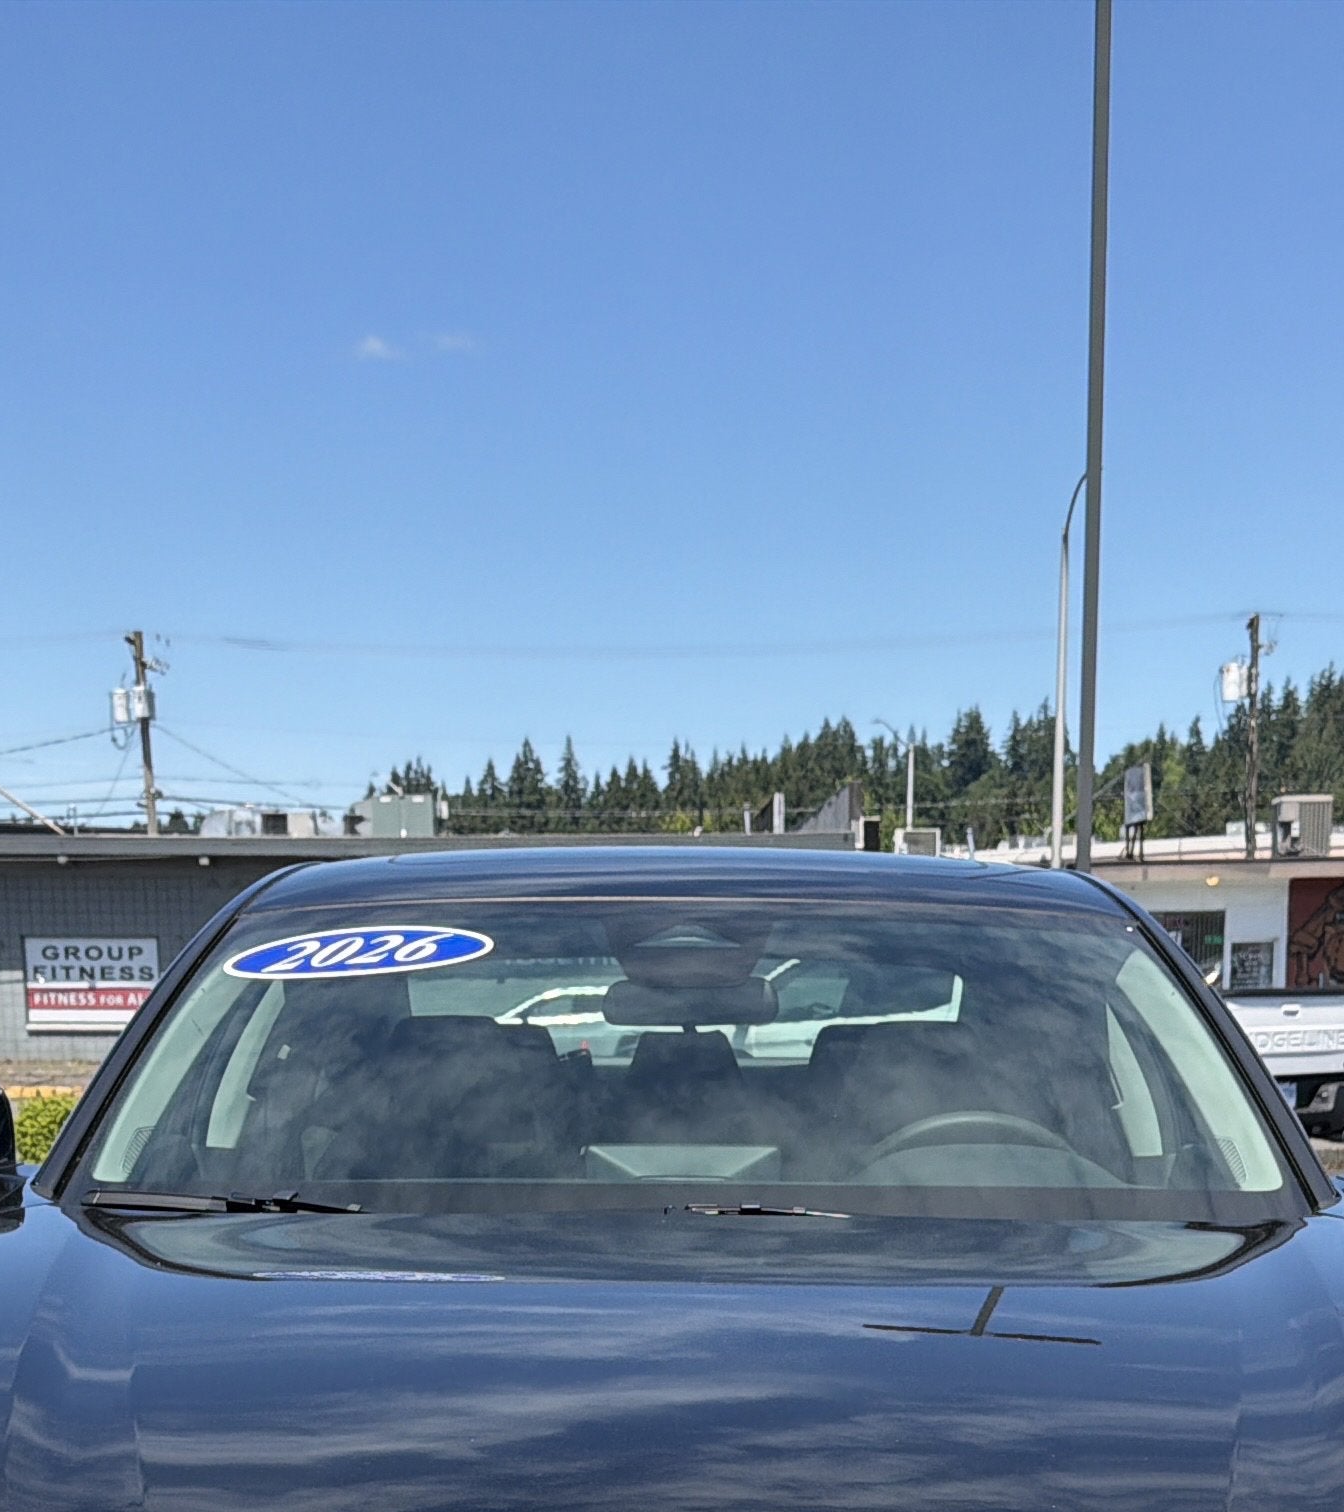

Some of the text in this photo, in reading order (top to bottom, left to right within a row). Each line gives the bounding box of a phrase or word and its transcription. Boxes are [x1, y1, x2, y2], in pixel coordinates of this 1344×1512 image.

[41, 945, 144, 961] GROUP
[260, 933, 456, 973] 2026
[33, 965, 155, 981] FITNESS
[33, 991, 96, 1007] FITNESS
